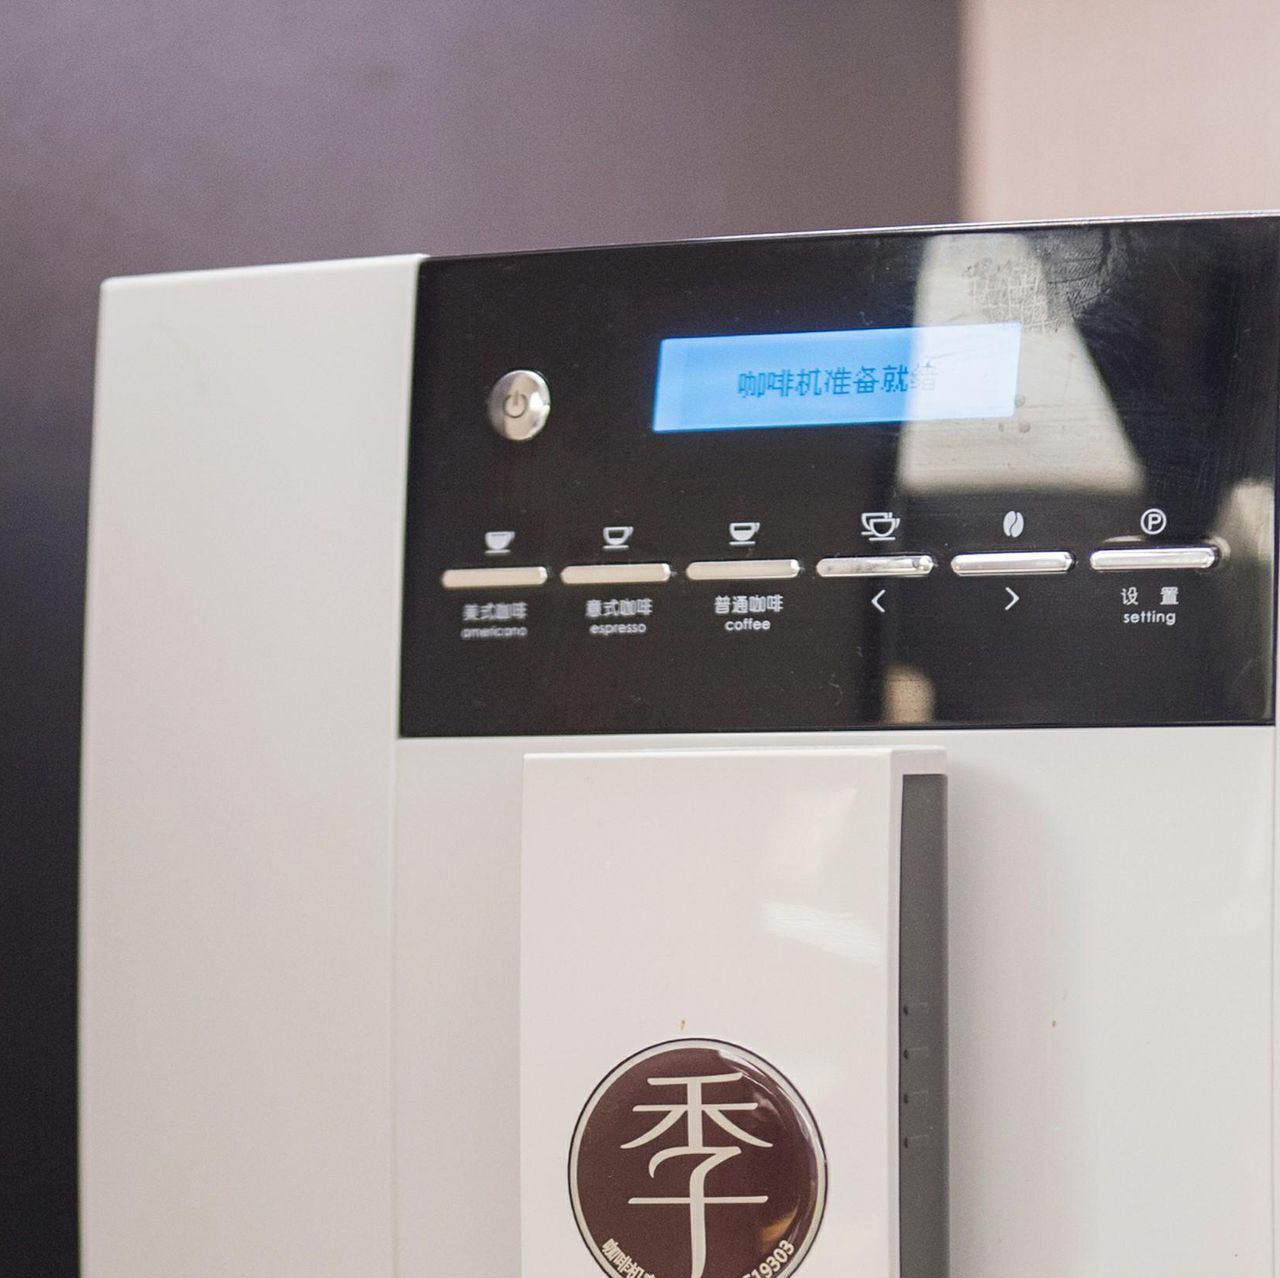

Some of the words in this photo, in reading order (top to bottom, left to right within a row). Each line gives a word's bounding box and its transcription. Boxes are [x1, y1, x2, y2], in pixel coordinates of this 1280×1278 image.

[586, 598, 653, 618] 意式咖啡
[714, 594, 784, 614] 普通咖啡
[724, 617, 771, 631] coffee
[1123, 610, 1176, 626] setting
[460, 625, 529, 640] americano
[589, 623, 647, 637] espresso
